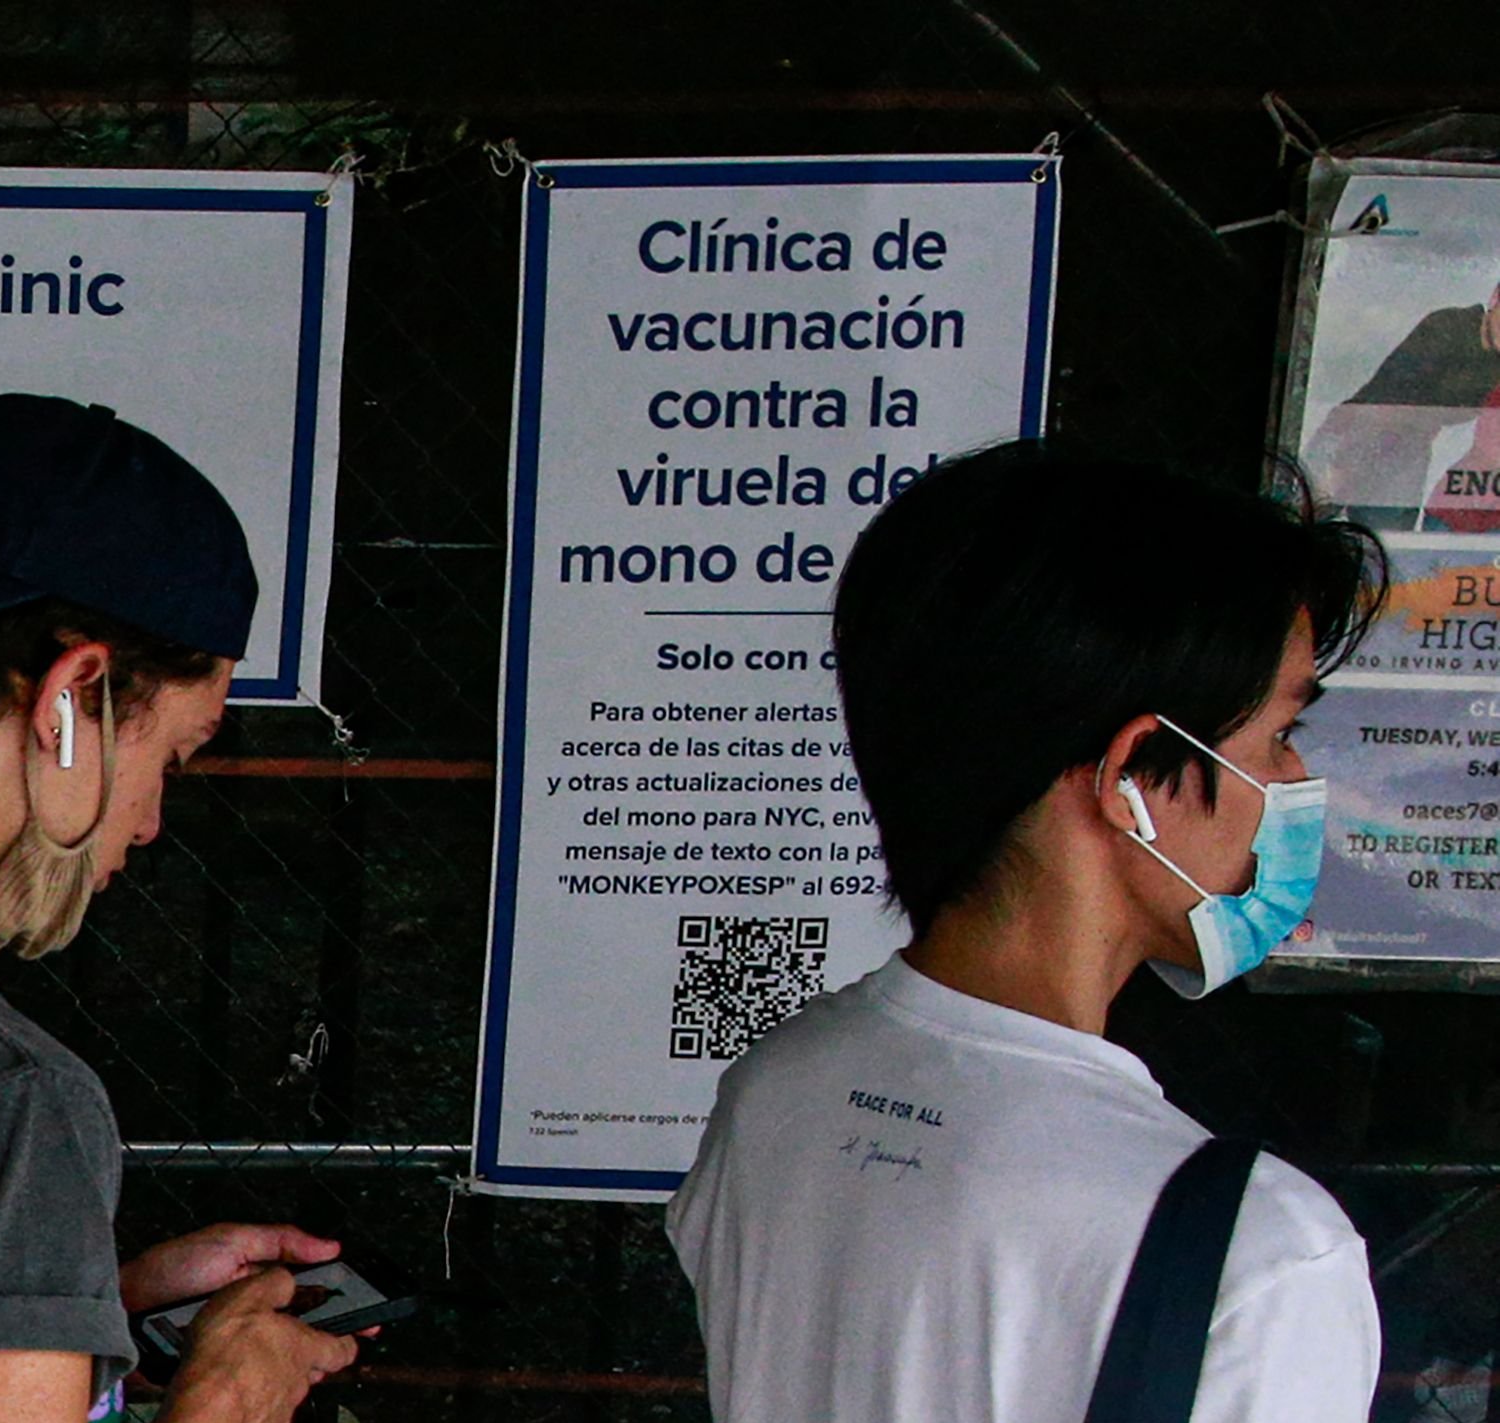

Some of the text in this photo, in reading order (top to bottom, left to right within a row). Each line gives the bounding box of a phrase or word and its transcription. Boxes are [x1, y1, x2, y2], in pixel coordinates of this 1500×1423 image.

[638, 216, 947, 274] Clínica de
[607, 294, 964, 352] vacunación
[648, 375, 918, 430] contra la
[617, 452, 827, 507] viruela
[560, 531, 834, 584] mono de
[1451, 575, 1500, 607] BU
[1419, 618, 1500, 652] HIG
[657, 643, 734, 671] Solo
[744, 650, 808, 671] con
[1473, 658, 1500, 671] AV
[590, 701, 838, 722] Para obtener alertas
[1469, 700, 1500, 717] CL
[561, 741, 641, 757] acerca
[648, 737, 679, 757] de
[686, 737, 720, 757] las
[727, 736, 784, 757] citas
[791, 737, 822, 757] de
[1359, 726, 1500, 749] TUESDAY, WE
[1467, 760, 1500, 777] 5:4
[547, 770, 860, 797] y otras actualizaciones de
[583, 806, 620, 826] del
[627, 811, 696, 827] mono
[703, 811, 757, 831] para
[764, 807, 825, 829] NYC,
[1402, 802, 1500, 821] oaces7@
[565, 840, 667, 865] mensaje
[673, 841, 704, 861] de
[711, 843, 772, 861] texto
[778, 846, 822, 862] con
[830, 842, 849, 861] la
[1384, 834, 1498, 856] REGISTER
[802, 876, 823, 896] al
[1407, 870, 1440, 889] OR
[848, 1090, 943, 1127] PEACE FOR ALL
